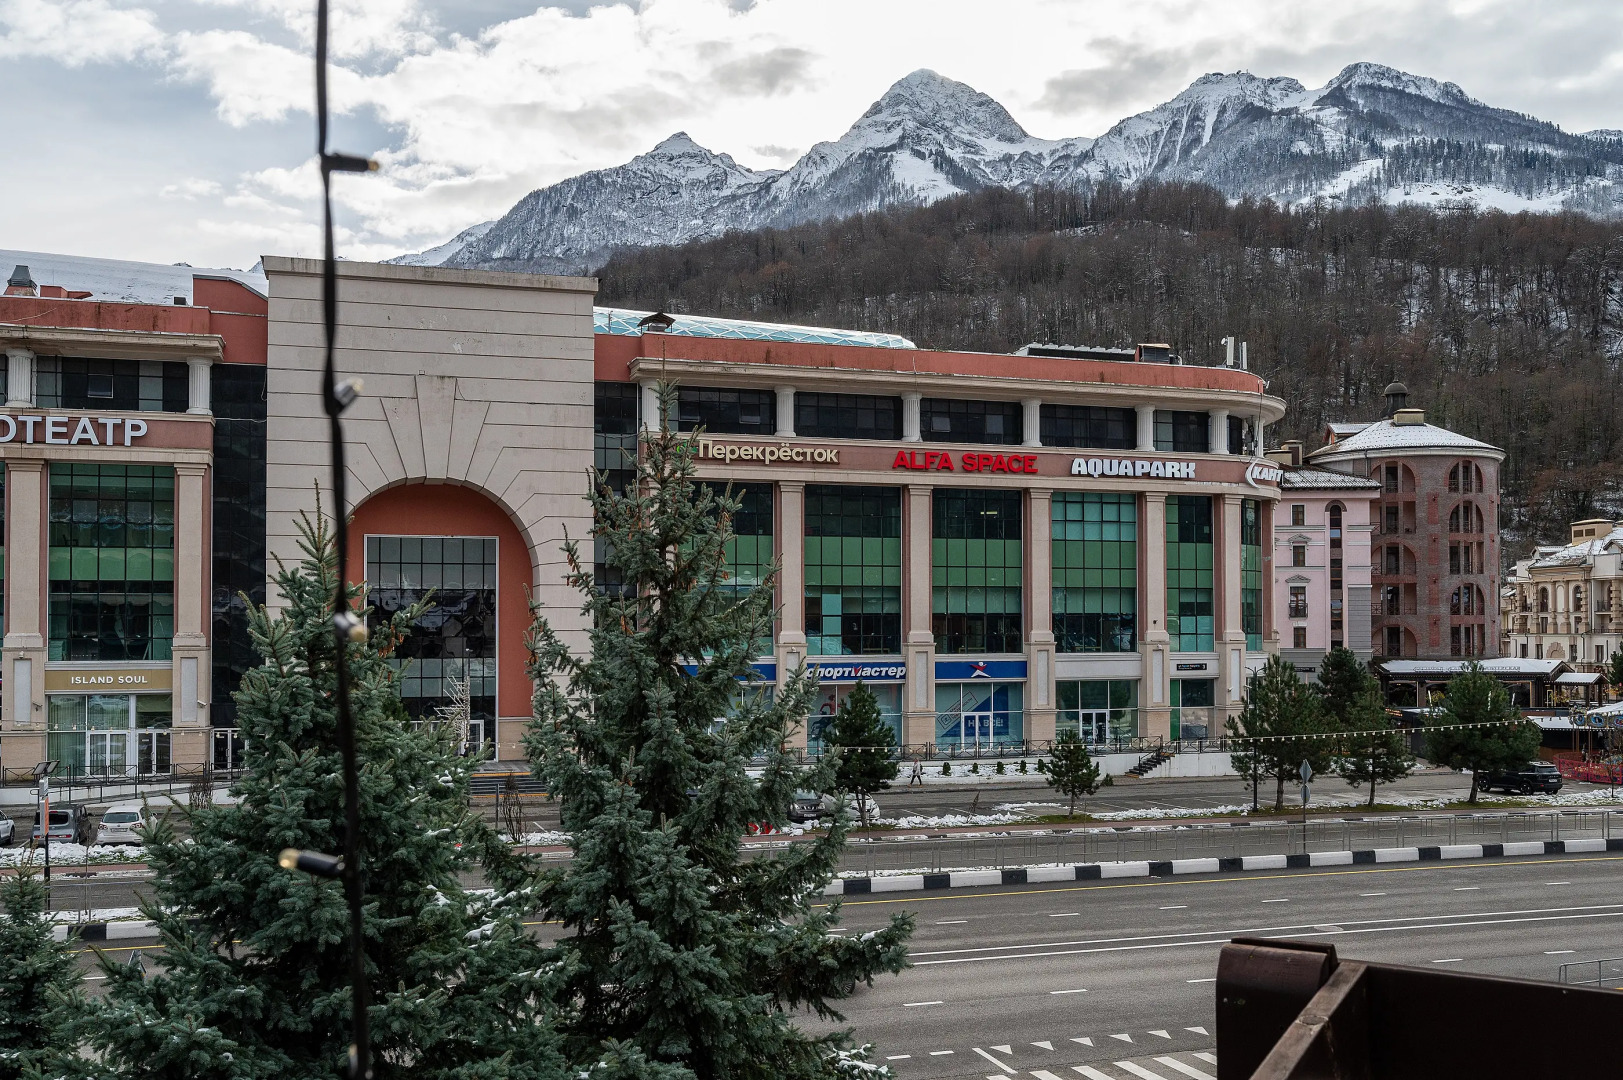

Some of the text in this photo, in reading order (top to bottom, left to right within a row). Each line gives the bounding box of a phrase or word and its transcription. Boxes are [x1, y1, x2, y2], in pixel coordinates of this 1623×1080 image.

[698, 440, 839, 465] Перекрёсток
[892, 450, 1039, 473] ALFA SPACE
[1071, 458, 1196, 479] AQUAPARK
[1252, 466, 1283, 482] КАНТ
[71, 675, 148, 684] ISLAND SOUL
